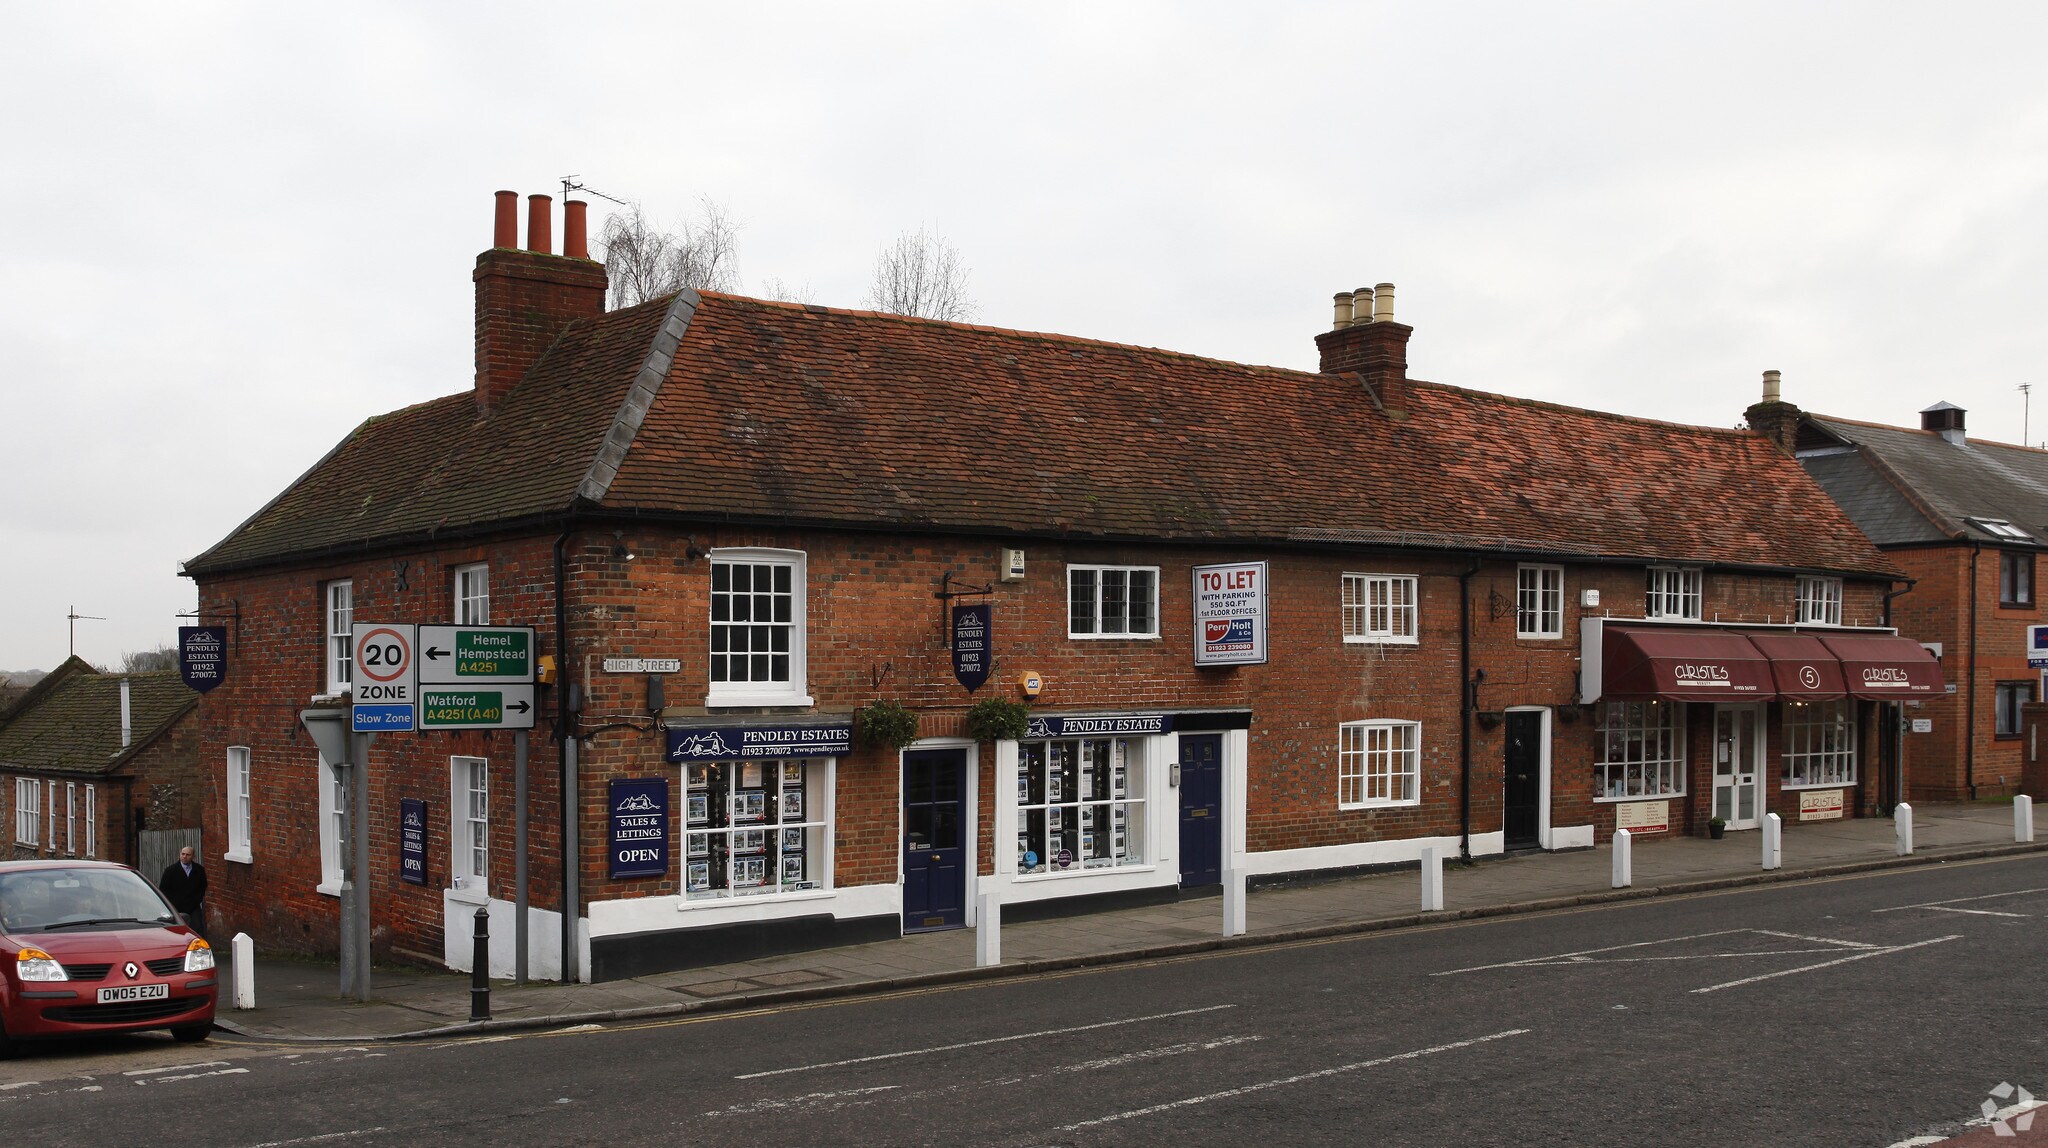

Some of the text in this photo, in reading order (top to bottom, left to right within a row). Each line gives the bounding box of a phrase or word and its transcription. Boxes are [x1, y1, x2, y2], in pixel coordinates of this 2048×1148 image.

[1201, 571, 1256, 591] TO LET
[1207, 621, 1251, 632] Perry Holt
[957, 630, 984, 638] PENDLEY
[473, 635, 511, 646] Hemel
[958, 640, 983, 649] ESTATES
[365, 644, 402, 666] 20
[459, 648, 526, 661] Hempstead
[961, 653, 979, 662] 01923
[606, 660, 678, 671] HIGH STREET
[960, 663, 981, 672] 270072
[190, 671, 217, 679] 270072
[1806, 670, 1815, 684] 5
[1027, 680, 1039, 688] ADT
[360, 685, 407, 699] ZONE
[427, 695, 476, 706] Watford
[355, 713, 411, 723] Slow Zone
[1062, 718, 1162, 732] PENDLEY ESTATES
[742, 729, 849, 743] PENDLEY ESTATES
[741, 744, 850, 756] 01923 270072 www.pendley.co.uk
[620, 817, 658, 827] SALES &
[403, 831, 417, 840] SALES
[616, 828, 662, 838] LETTINGS
[403, 841, 422, 851] LETTINGS
[618, 848, 660, 863] OPEN
[404, 858, 421, 871] OPEN
[103, 986, 164, 1000] OW05 EZU
